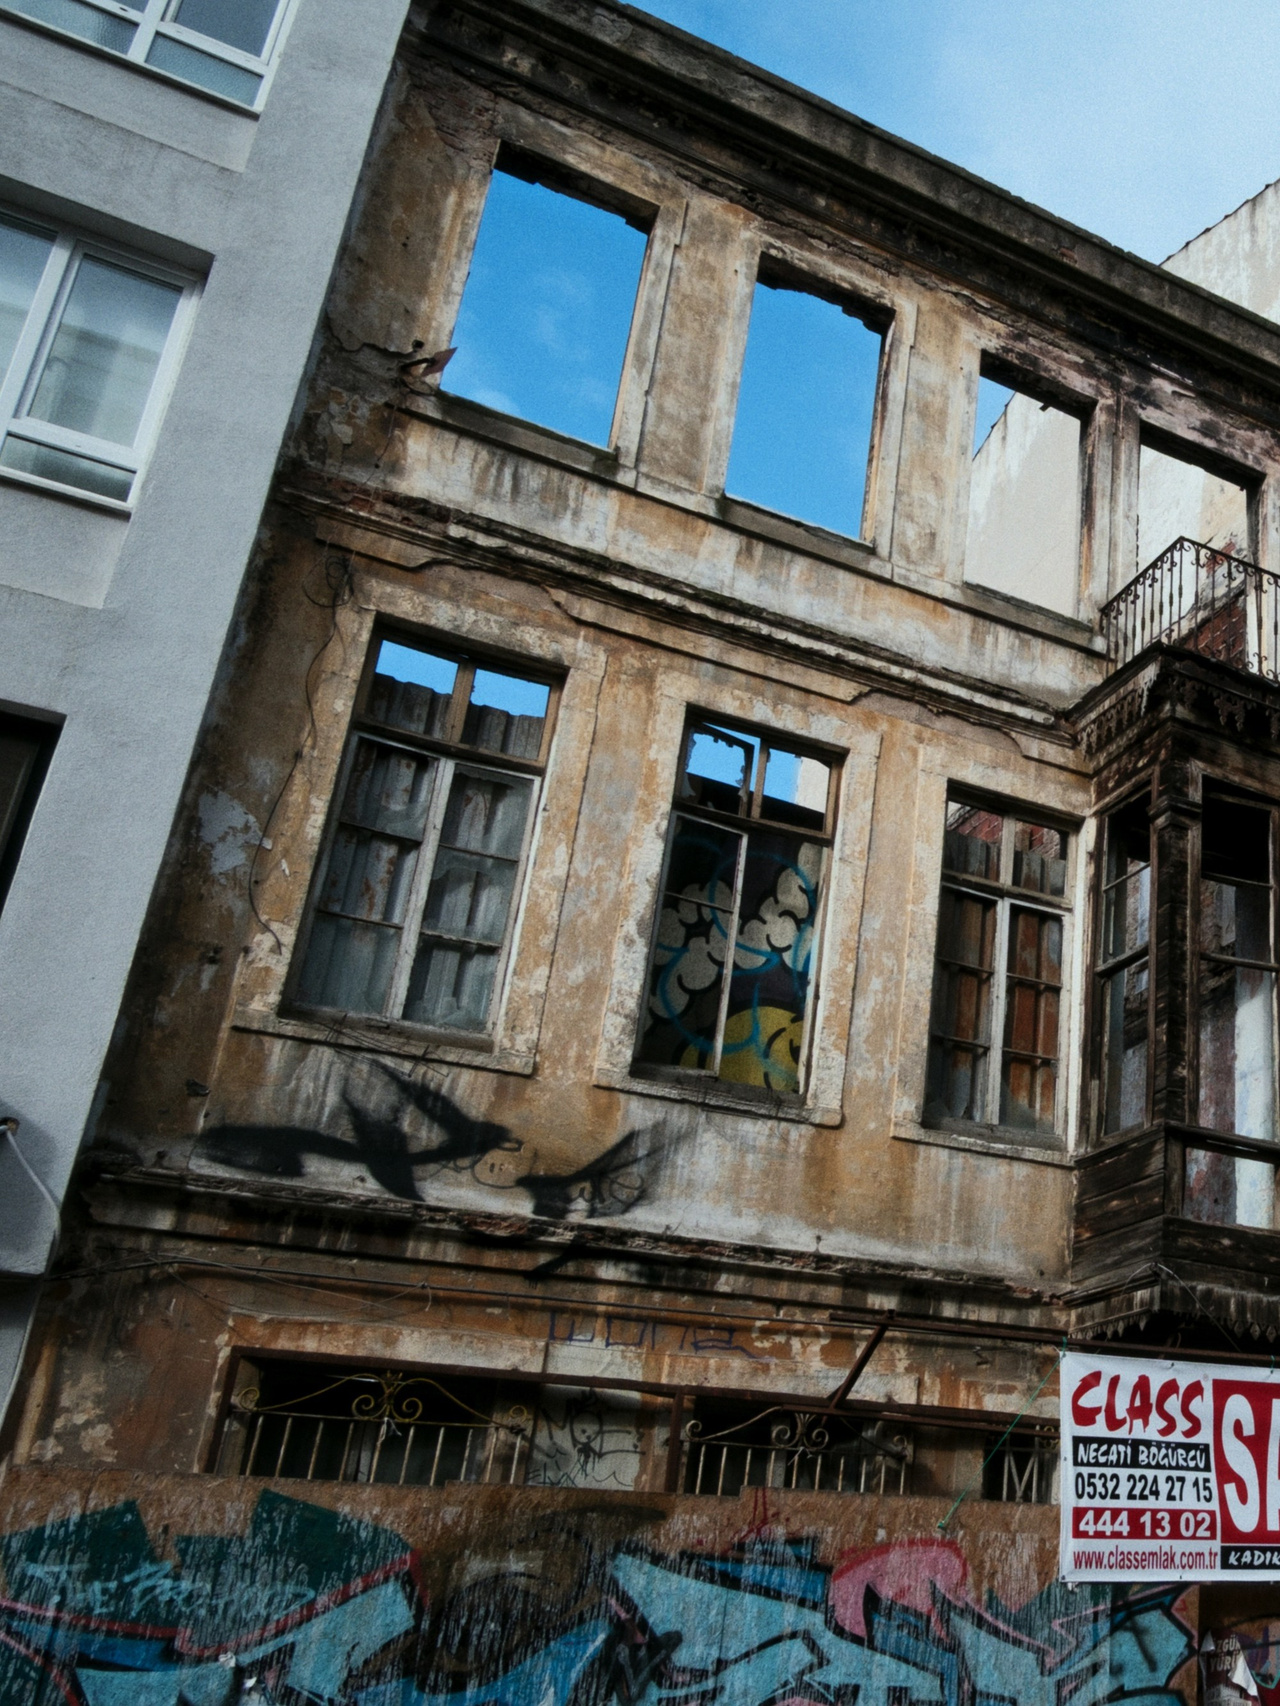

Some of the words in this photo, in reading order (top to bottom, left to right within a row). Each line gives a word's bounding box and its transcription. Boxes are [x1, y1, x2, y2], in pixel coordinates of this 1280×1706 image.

[1071, 1370, 1204, 1438] CLASS
[1078, 1440, 1131, 1466] NECATİ
[1138, 1441, 1205, 1469] BÖĞÜRCÜ
[1075, 1472, 1120, 1500] 0532
[1127, 1474, 1160, 1501] 224
[1165, 1475, 1186, 1502] 27
[1192, 1476, 1213, 1503] 15
[1079, 1510, 1130, 1536] 444
[1140, 1511, 1171, 1537] 13
[1180, 1511, 1211, 1537] 02
[1073, 1544, 1218, 1570] www.classemlak.com.tr
[1213, 1634, 1241, 1653] ZGÜ
